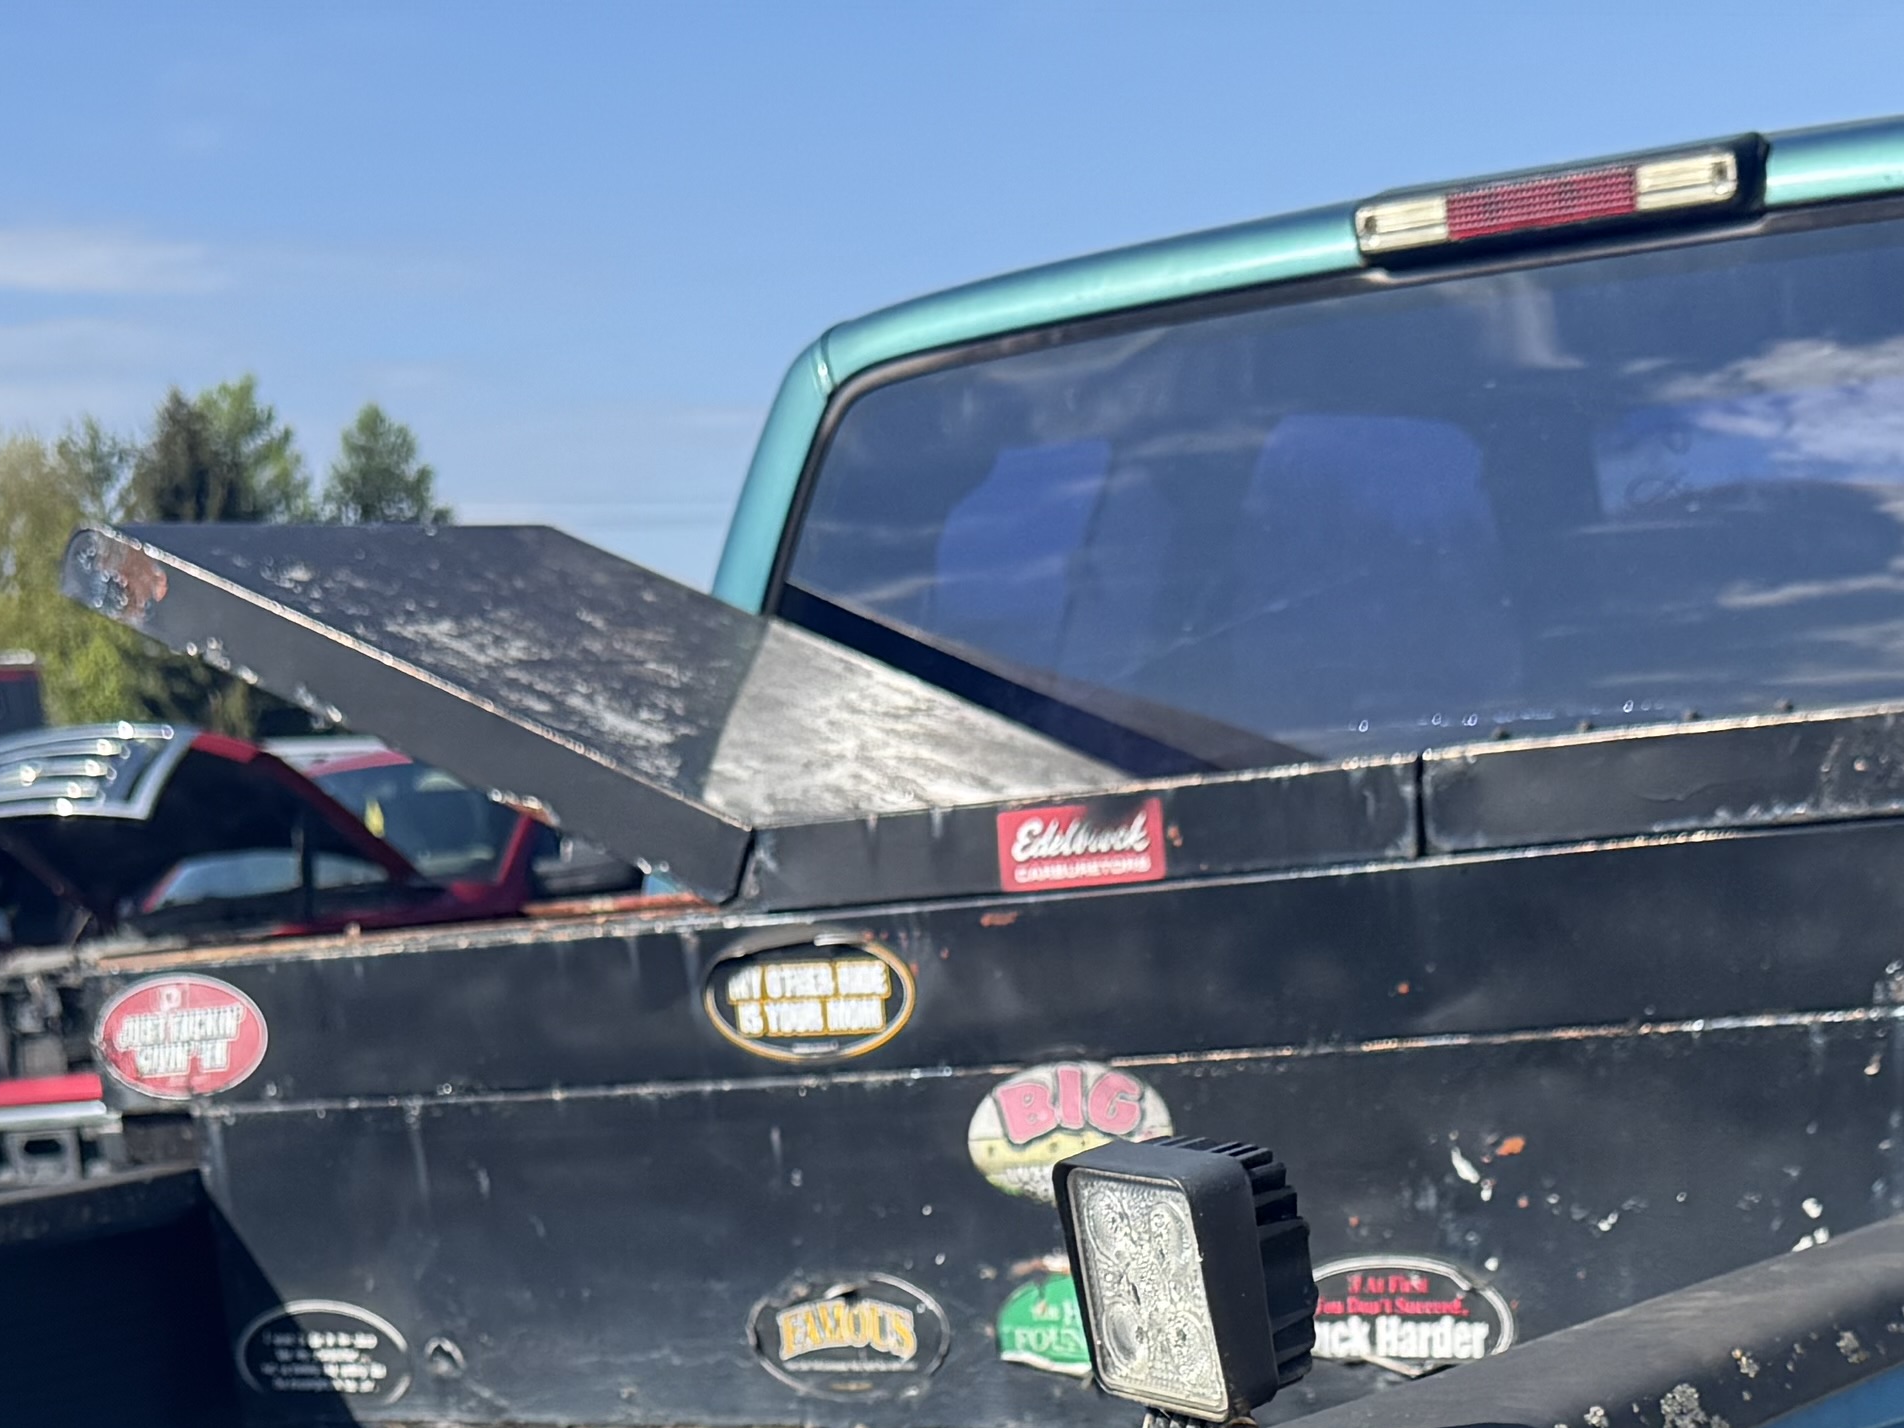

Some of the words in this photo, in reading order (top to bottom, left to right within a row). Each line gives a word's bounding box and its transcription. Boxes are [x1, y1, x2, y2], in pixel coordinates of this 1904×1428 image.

[1011, 810, 1151, 862] Edelbrock
[996, 1064, 1143, 1145] BIG
[776, 1299, 917, 1361] FAMOUS
[1346, 1296, 1394, 1316] Don't
[1312, 1315, 1371, 1358] uck
[1375, 1314, 1490, 1359] Harder
